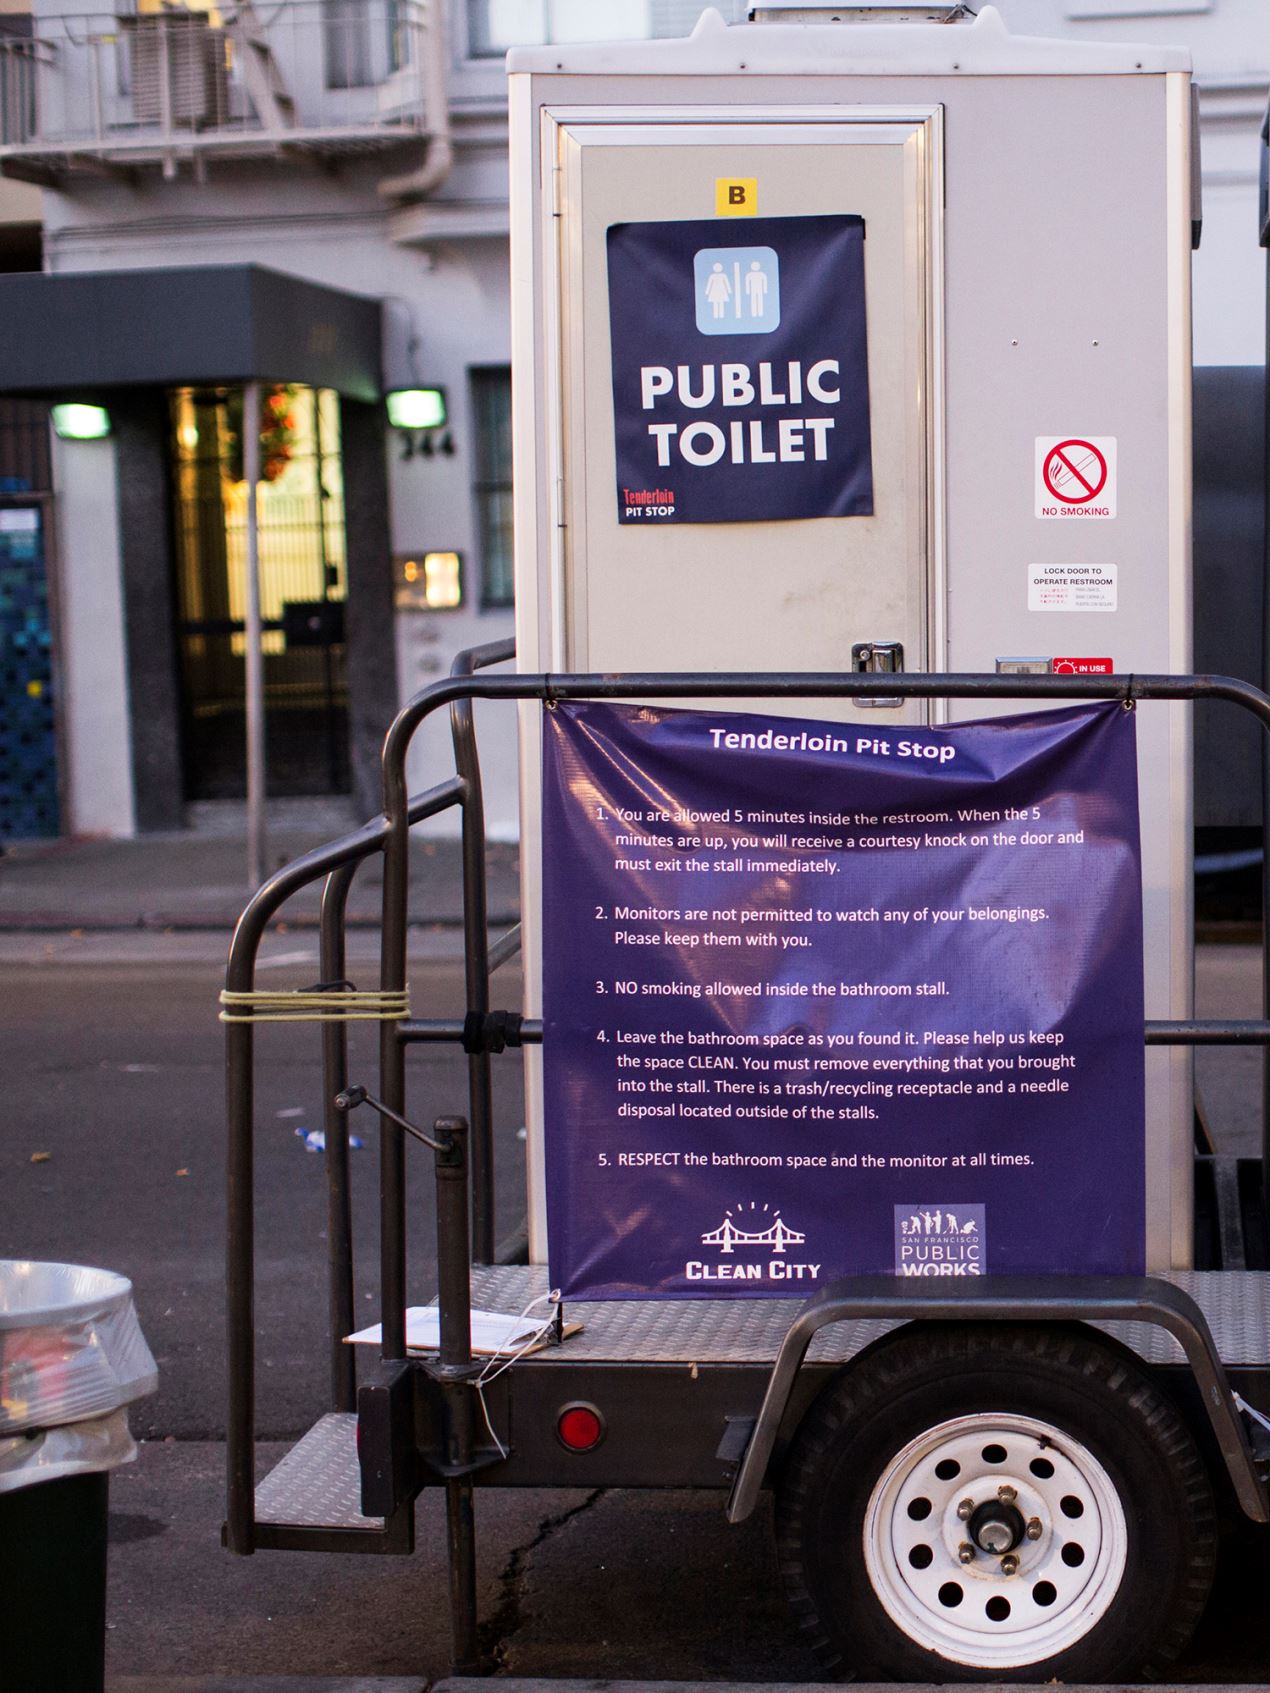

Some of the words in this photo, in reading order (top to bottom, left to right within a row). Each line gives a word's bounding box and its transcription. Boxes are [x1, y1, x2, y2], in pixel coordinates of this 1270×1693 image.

[729, 186, 746, 205] B
[641, 359, 841, 409] PUBLIC
[648, 417, 835, 467] TOILET
[623, 488, 675, 505] Tenderloin
[625, 507, 642, 517] PIT
[645, 506, 675, 517] STOP
[1042, 507, 1057, 516] NO
[1060, 507, 1109, 516] SMOKING
[709, 728, 848, 752] Tenderloin
[856, 738, 890, 755] Pit
[897, 741, 956, 763] Stop
[596, 807, 609, 821] 1.
[616, 808, 642, 822] You
[647, 811, 669, 822] are
[674, 809, 730, 823] allowed
[734, 810, 743, 823] 5
[748, 809, 805, 824] minutes
[809, 811, 850, 825] inside
[855, 813, 878, 825] the
[883, 812, 953, 824] restroom.
[957, 809, 1000, 822] When
[1004, 807, 1028, 820] the
[1032, 807, 1041, 820] 5
[615, 834, 673, 847] minutes
[678, 836, 701, 847] are
[705, 836, 727, 850] up,
[732, 837, 758, 850] you
[762, 834, 787, 848] will
[792, 834, 843, 848] receive
[847, 837, 855, 848] a
[859, 835, 920, 850] courtesy
[925, 832, 967, 846] knock
[971, 836, 988, 846] on
[993, 832, 1016, 845] the
[1020, 831, 1054, 845] door
[1058, 830, 1084, 844] and
[615, 857, 651, 871] must
[655, 858, 682, 872] exit
[685, 858, 709, 872] the
[713, 858, 743, 873] stall
[747, 859, 840, 876] immediately.
[595, 906, 608, 920] 2.
[615, 906, 680, 921] Monitors
[684, 910, 708, 921] are
[712, 909, 737, 921] not
[741, 908, 812, 925] permitted
[816, 910, 832, 922] to
[836, 908, 879, 922] watch
[883, 911, 910, 925] any
[913, 907, 929, 922] of
[932, 911, 965, 925] your
[969, 906, 1049, 923] belongings.
[615, 931, 660, 946] Please
[665, 931, 699, 949] keep
[703, 932, 741, 946] them
[746, 932, 777, 947] with
[781, 936, 812, 950] you.
[596, 981, 608, 994] 3.
[615, 981, 638, 995] NO
[642, 981, 701, 999] smoking
[705, 982, 761, 997] allowed
[766, 982, 808, 997] inside
[812, 982, 836, 997] the
[840, 982, 911, 997] bathroom
[916, 981, 949, 997] stall.
[597, 1030, 610, 1043] 4.
[617, 1030, 656, 1045] Leave
[660, 1031, 684, 1045] the
[688, 1031, 759, 1046] bathroom
[763, 1032, 804, 1049] space
[808, 1035, 823, 1046] as
[827, 1035, 854, 1049] you
[858, 1031, 900, 1046] found
[905, 1032, 919, 1046] it.
[924, 1031, 969, 1046] Please
[973, 1030, 1005, 1048] help
[1009, 1034, 1025, 1045] us
[1029, 1030, 1064, 1047] keep
[616, 1054, 640, 1068] the
[644, 1058, 684, 1071] space
[688, 1056, 738, 1070] CLEAN.
[742, 1057, 769, 1071] You
[774, 1058, 810, 1071] must
[814, 1060, 869, 1071] remove
[873, 1056, 950, 1073] everything
[953, 1055, 983, 1070] that
[987, 1059, 1013, 1073] you
[1018, 1054, 1076, 1071] brought
[618, 1079, 646, 1093] into
[649, 1078, 673, 1093] the
[677, 1080, 710, 1094] stall.
[714, 1080, 755, 1095] There
[759, 1081, 770, 1095] is
[773, 1085, 782, 1095] a
[785, 1080, 893, 1099] trash/recycling
[897, 1080, 972, 1098] receptacle
[977, 1080, 1003, 1095] and
[1008, 1083, 1016, 1094] a
[1021, 1078, 1069, 1094] needle
[618, 1103, 675, 1120] disposal
[680, 1103, 731, 1118] located
[736, 1105, 788, 1119] outside
[792, 1105, 807, 1119] of
[810, 1106, 834, 1120] the
[839, 1105, 879, 1120] stalls.
[598, 1153, 611, 1167] 5.
[618, 1153, 681, 1167] RESPECT
[684, 1152, 708, 1166] the
[712, 1152, 782, 1167] bathroom
[786, 1156, 827, 1170] space
[831, 1153, 857, 1168] and
[861, 1154, 885, 1168] the
[890, 1154, 948, 1168] monitor
[952, 1155, 966, 1167] at
[970, 1153, 986, 1167] all
[990, 1153, 1034, 1166] times.
[902, 1236, 920, 1244] SAN
[924, 1236, 979, 1244] FRANCISCO
[901, 1245, 980, 1261] PUBLIC
[686, 1261, 762, 1280] CLEAN
[769, 1261, 821, 1280] CITY
[902, 1263, 981, 1276] WORKS
